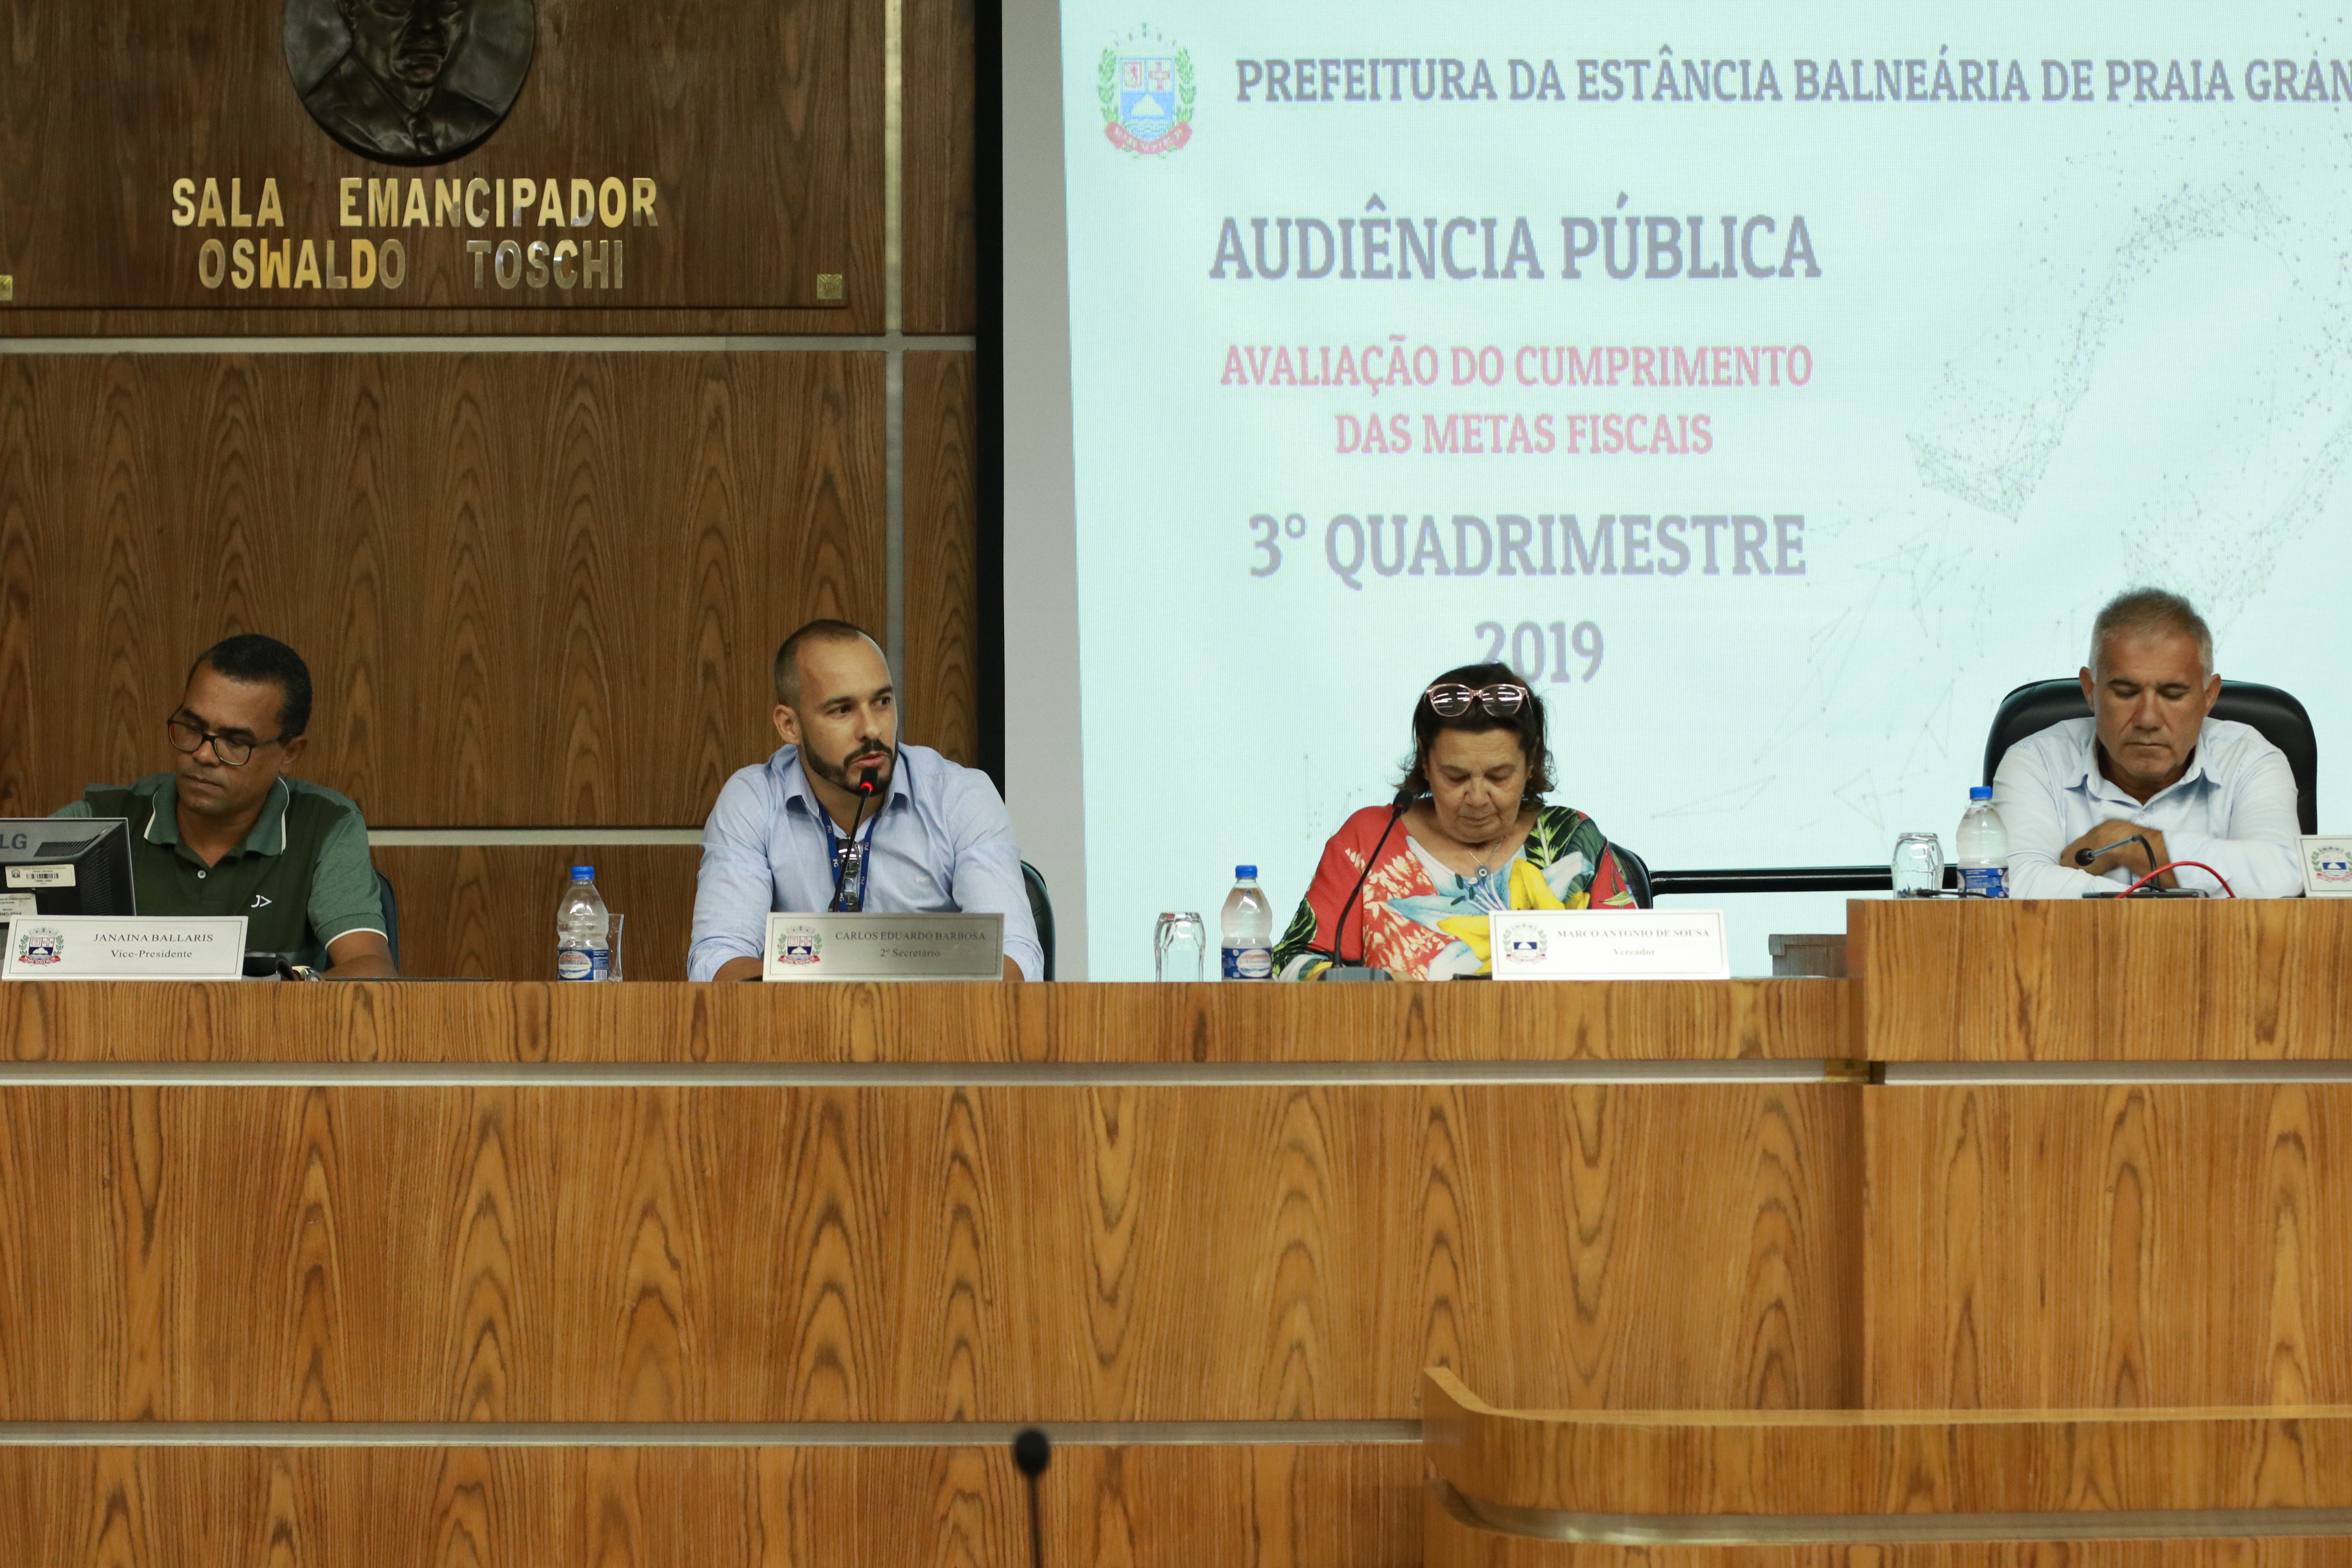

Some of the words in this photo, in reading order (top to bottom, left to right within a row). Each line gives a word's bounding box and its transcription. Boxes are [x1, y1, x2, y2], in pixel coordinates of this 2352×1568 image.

[1236, 58, 1497, 102] PREFEITURA
[1508, 59, 1566, 102] DA
[1576, 44, 1783, 102] ESTÂNCIA
[1794, 44, 2030, 102] BALNEÁRIA
[2041, 59, 2094, 102] DE
[2106, 59, 2234, 102] PRAIA
[171, 177, 284, 227] SALA
[340, 176, 658, 227] EMANCIPADOR
[1209, 194, 1544, 280] AUDIÊNCIA
[1561, 192, 1822, 280] PÚBLICA
[198, 238, 406, 289] OSWALDO
[467, 239, 624, 289] TOSCHI
[1220, 334, 1439, 397] AVALIAÇÃO
[1450, 345, 1504, 386] DO
[1515, 344, 1813, 387] CUMPRIMENTO
[1335, 413, 1412, 454] DAS
[1423, 414, 1555, 454] METAS
[1567, 414, 1713, 454] FISCAIS
[1325, 514, 1806, 591] QUADRIMESTRE
[1475, 621, 1604, 683] 2019
[0, 833, 27, 849] LG
[111, 950, 192, 958] Vice-Presidente
[836, 931, 877, 941] CARLOS
[880, 931, 933, 941] EDUARDO
[935, 931, 985, 941] BARBOSA
[893, 949, 940, 958] Secretário
[1557, 929, 1599, 938] MARCO
[1603, 929, 1654, 938] ANTONIO
[1656, 929, 1671, 938] DE
[1674, 929, 1710, 938] SOUSA
[1614, 948, 1655, 956] Vereador
